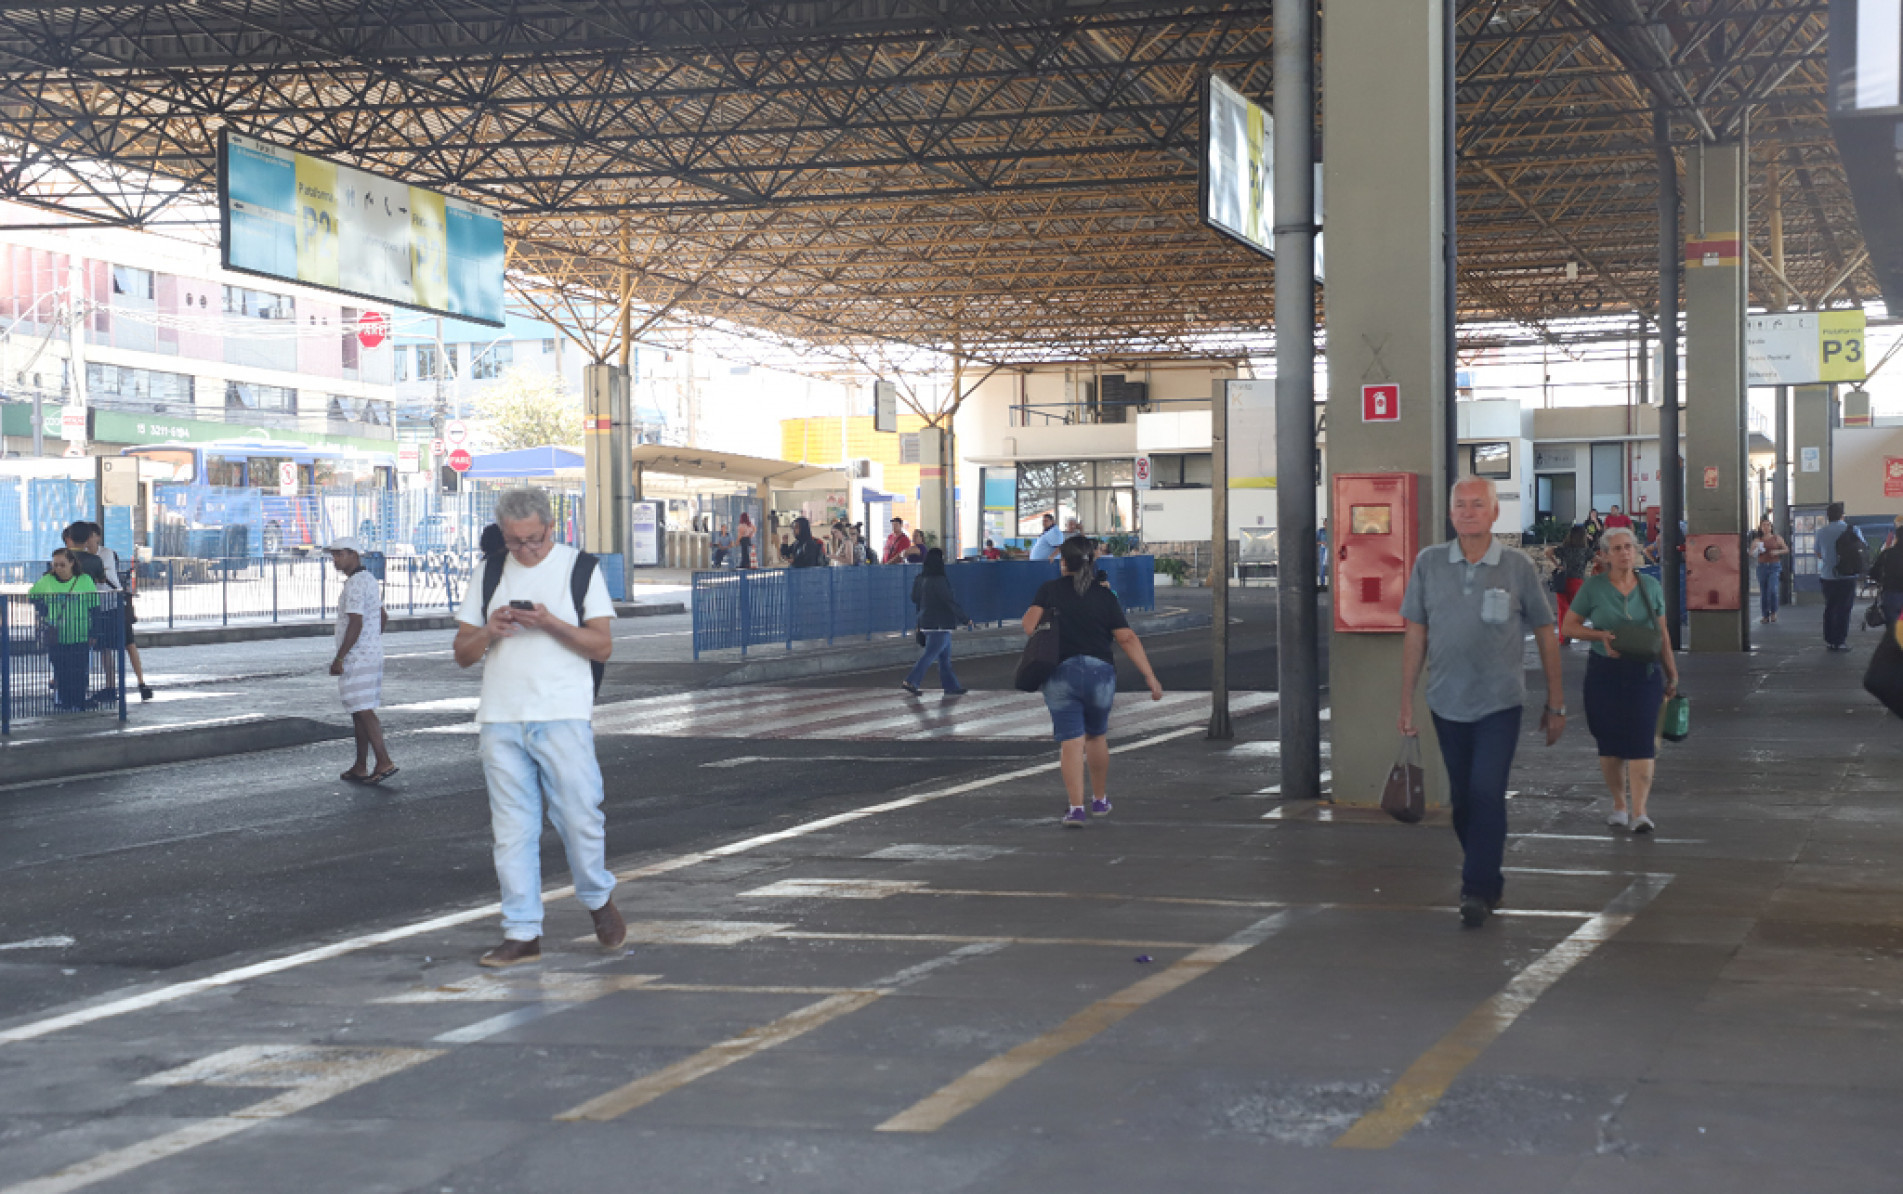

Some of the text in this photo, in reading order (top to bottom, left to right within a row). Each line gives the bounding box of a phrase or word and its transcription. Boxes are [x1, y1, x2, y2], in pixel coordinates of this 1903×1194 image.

[303, 206, 332, 258] P2
[1822, 339, 1862, 364] P3
[1232, 392, 1242, 406] K
[450, 456, 471, 464] PARE
